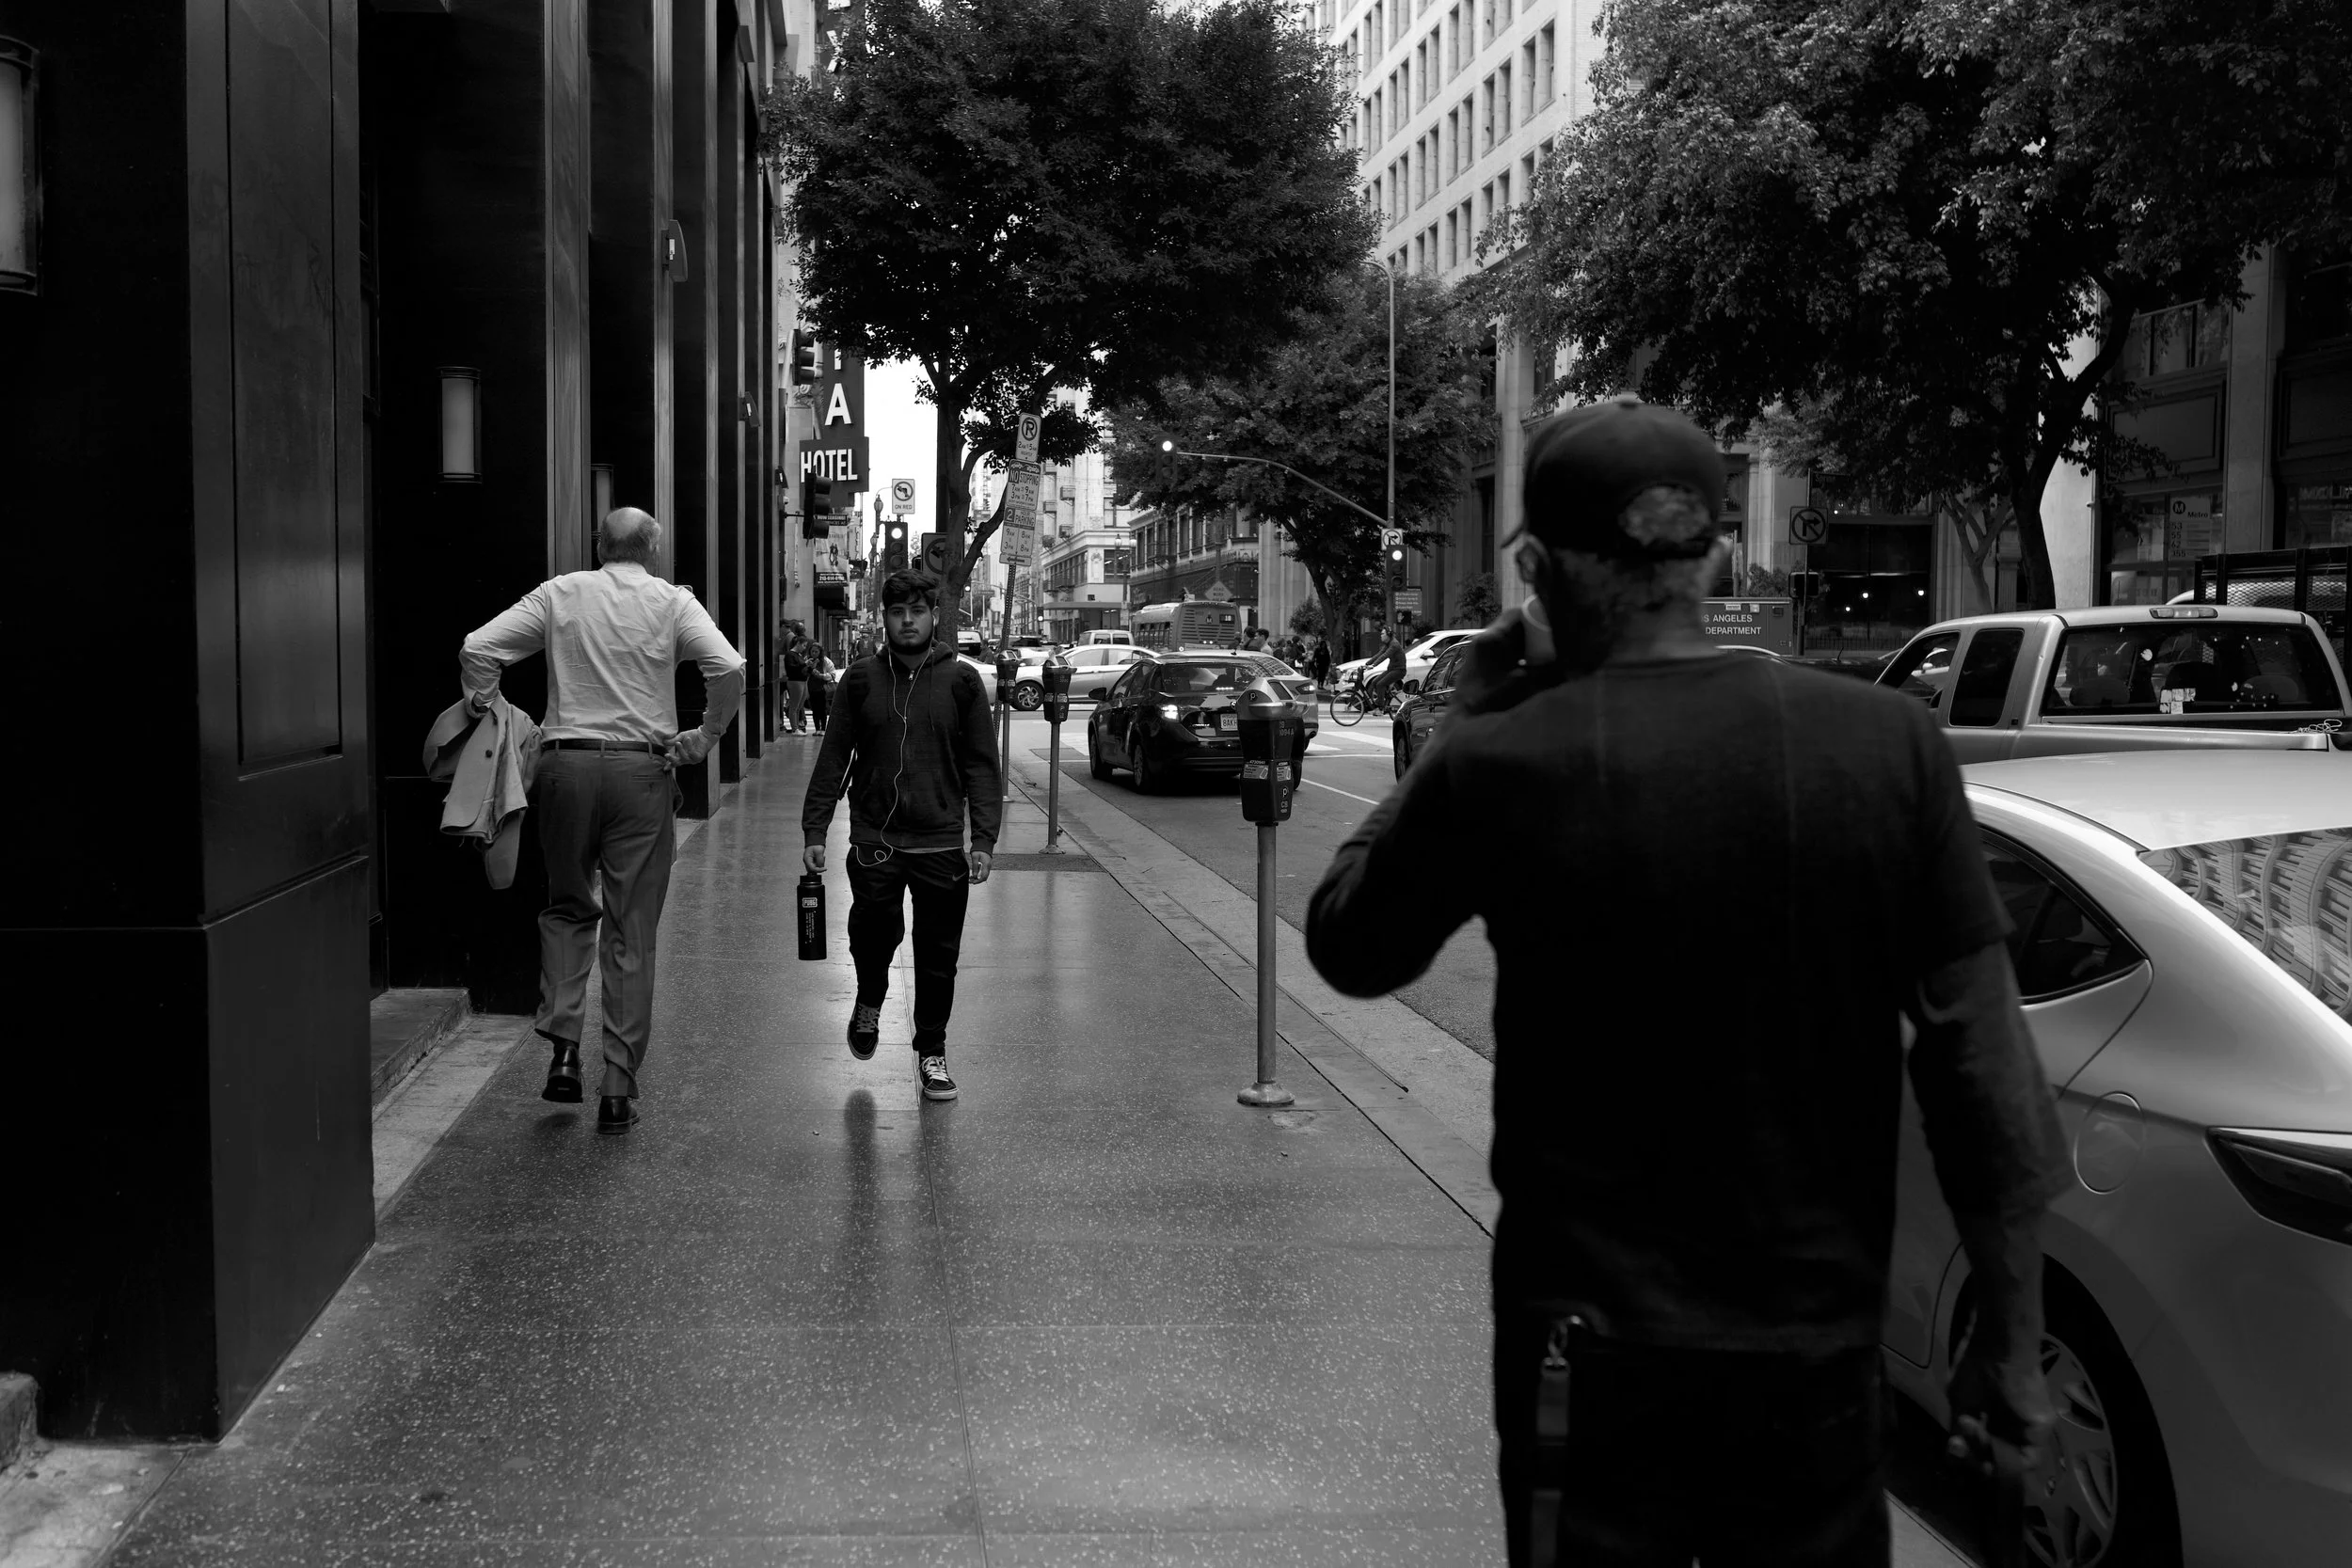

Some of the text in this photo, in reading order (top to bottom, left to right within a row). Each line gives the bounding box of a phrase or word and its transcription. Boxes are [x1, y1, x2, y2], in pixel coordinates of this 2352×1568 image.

[801, 448, 858, 483] HOTEL
[1009, 469, 1040, 486] NO STOPPING
[1007, 509, 1013, 521] 2
[1015, 515, 1035, 527] PARKING
[1713, 614, 1753, 623] ANGELES
[1705, 626, 1762, 635] DEPARTMENT
